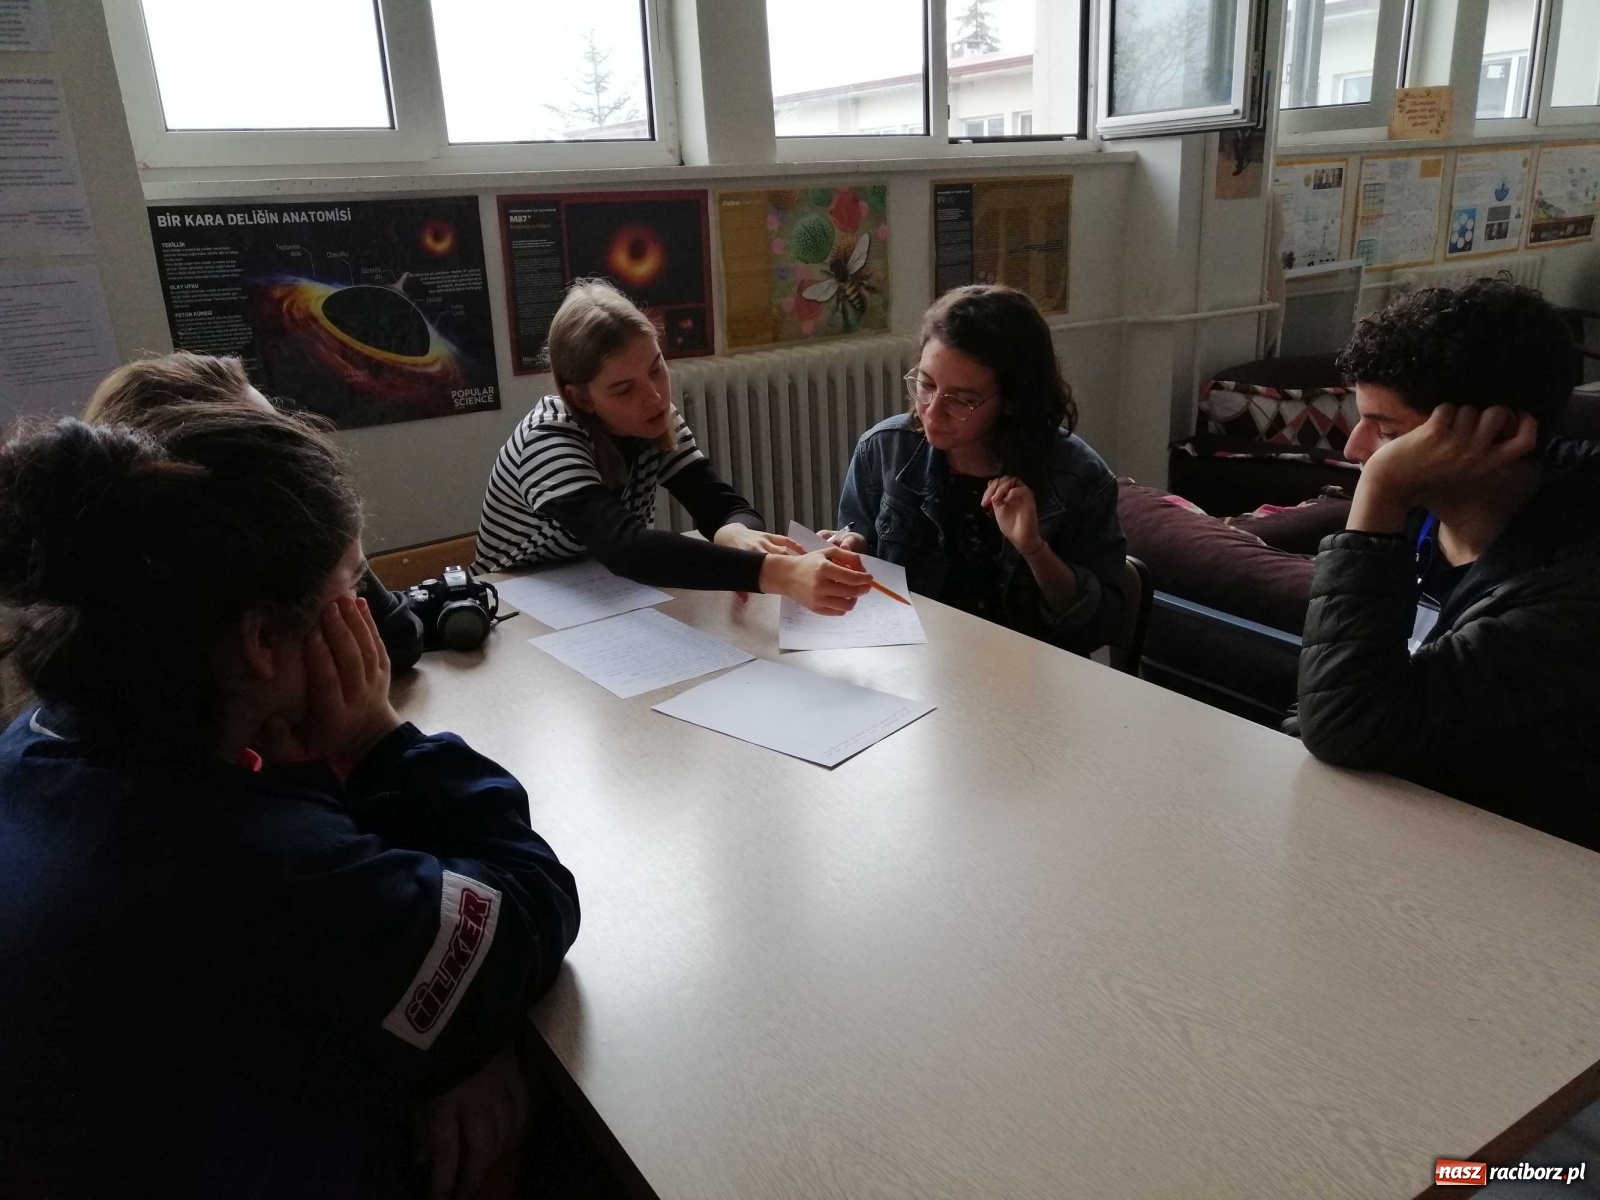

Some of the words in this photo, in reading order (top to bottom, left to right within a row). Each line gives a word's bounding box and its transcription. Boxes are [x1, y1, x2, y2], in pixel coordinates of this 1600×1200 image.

[157, 212, 182, 227] BİR
[185, 213, 225, 226] KARA
[227, 210, 279, 225] DELİĞİN
[283, 207, 352, 223] ANATOMİSİ
[451, 386, 494, 399] POPULAR
[453, 394, 494, 407] SCIENCE
